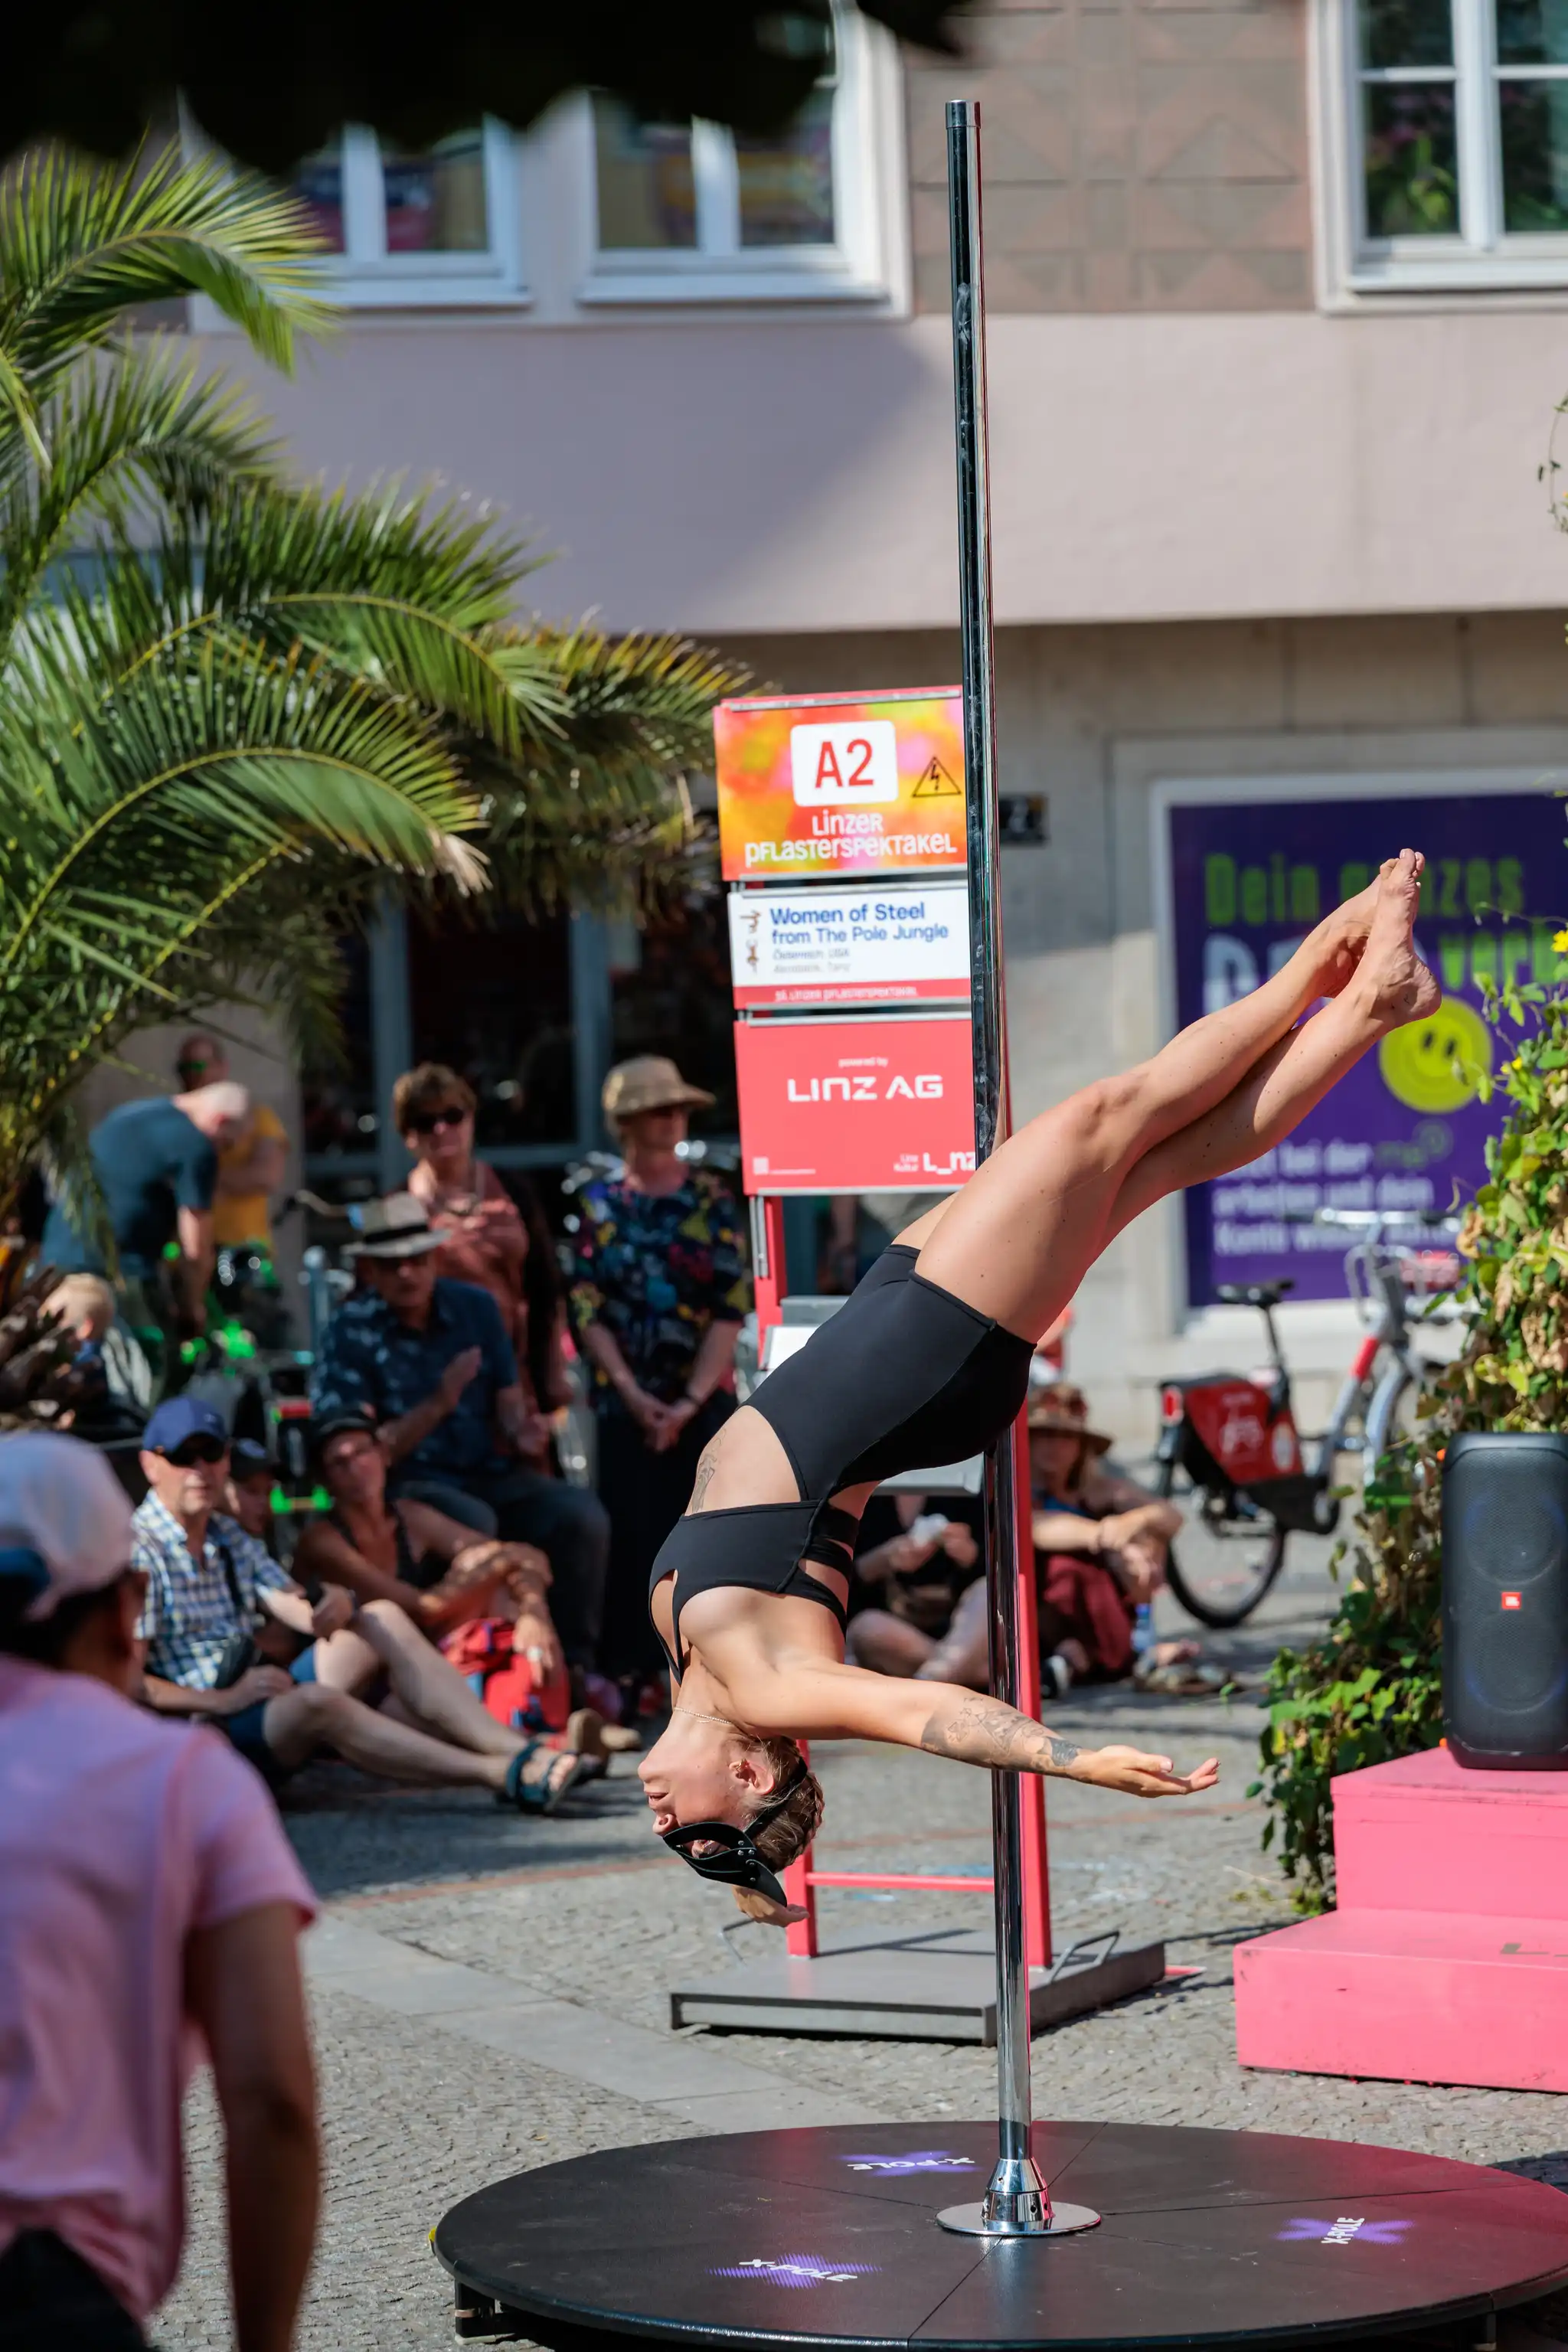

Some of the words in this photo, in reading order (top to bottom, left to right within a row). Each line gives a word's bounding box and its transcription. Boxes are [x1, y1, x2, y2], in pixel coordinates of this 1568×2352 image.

[815, 738, 874, 789] A2
[770, 907, 843, 925] Women
[849, 903, 867, 922] of
[874, 902, 925, 920] Steel
[772, 929, 812, 945] from
[815, 926, 847, 943] The
[852, 925, 887, 942] Pole
[893, 923, 949, 942] Jungle
[885, 1075, 943, 1099] AG
